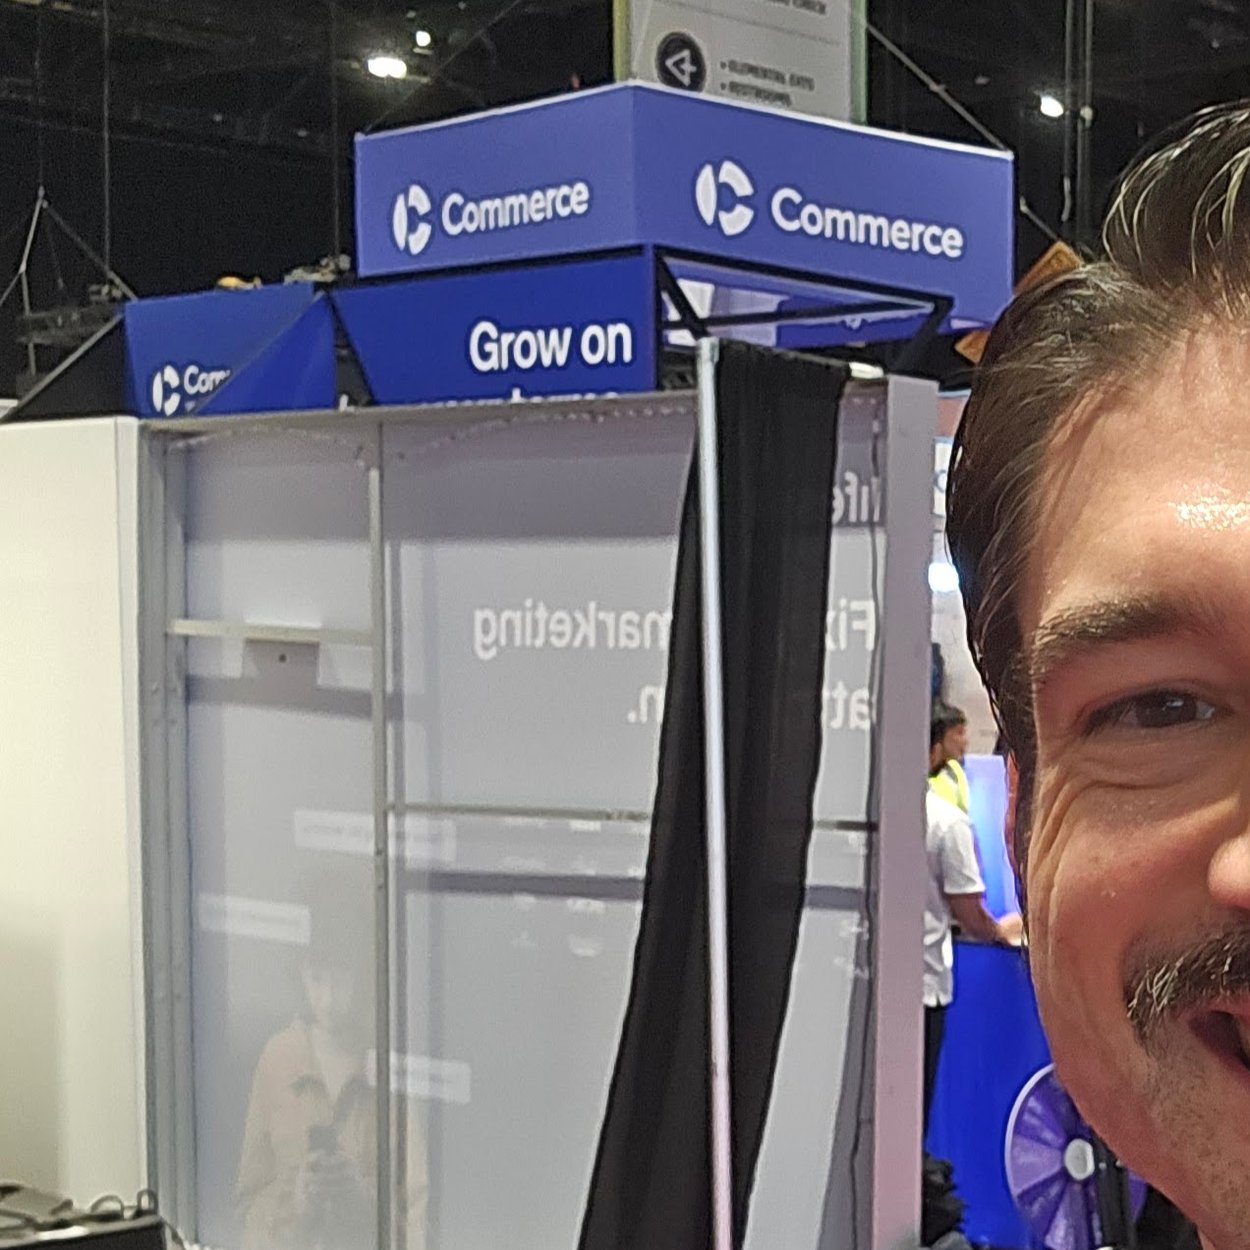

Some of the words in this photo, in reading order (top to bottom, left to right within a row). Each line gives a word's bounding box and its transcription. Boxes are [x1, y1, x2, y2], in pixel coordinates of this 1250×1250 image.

[441, 181, 590, 236] Commerce
[771, 188, 964, 259] Commerce
[469, 320, 571, 373] Grow
[579, 320, 633, 366] on
